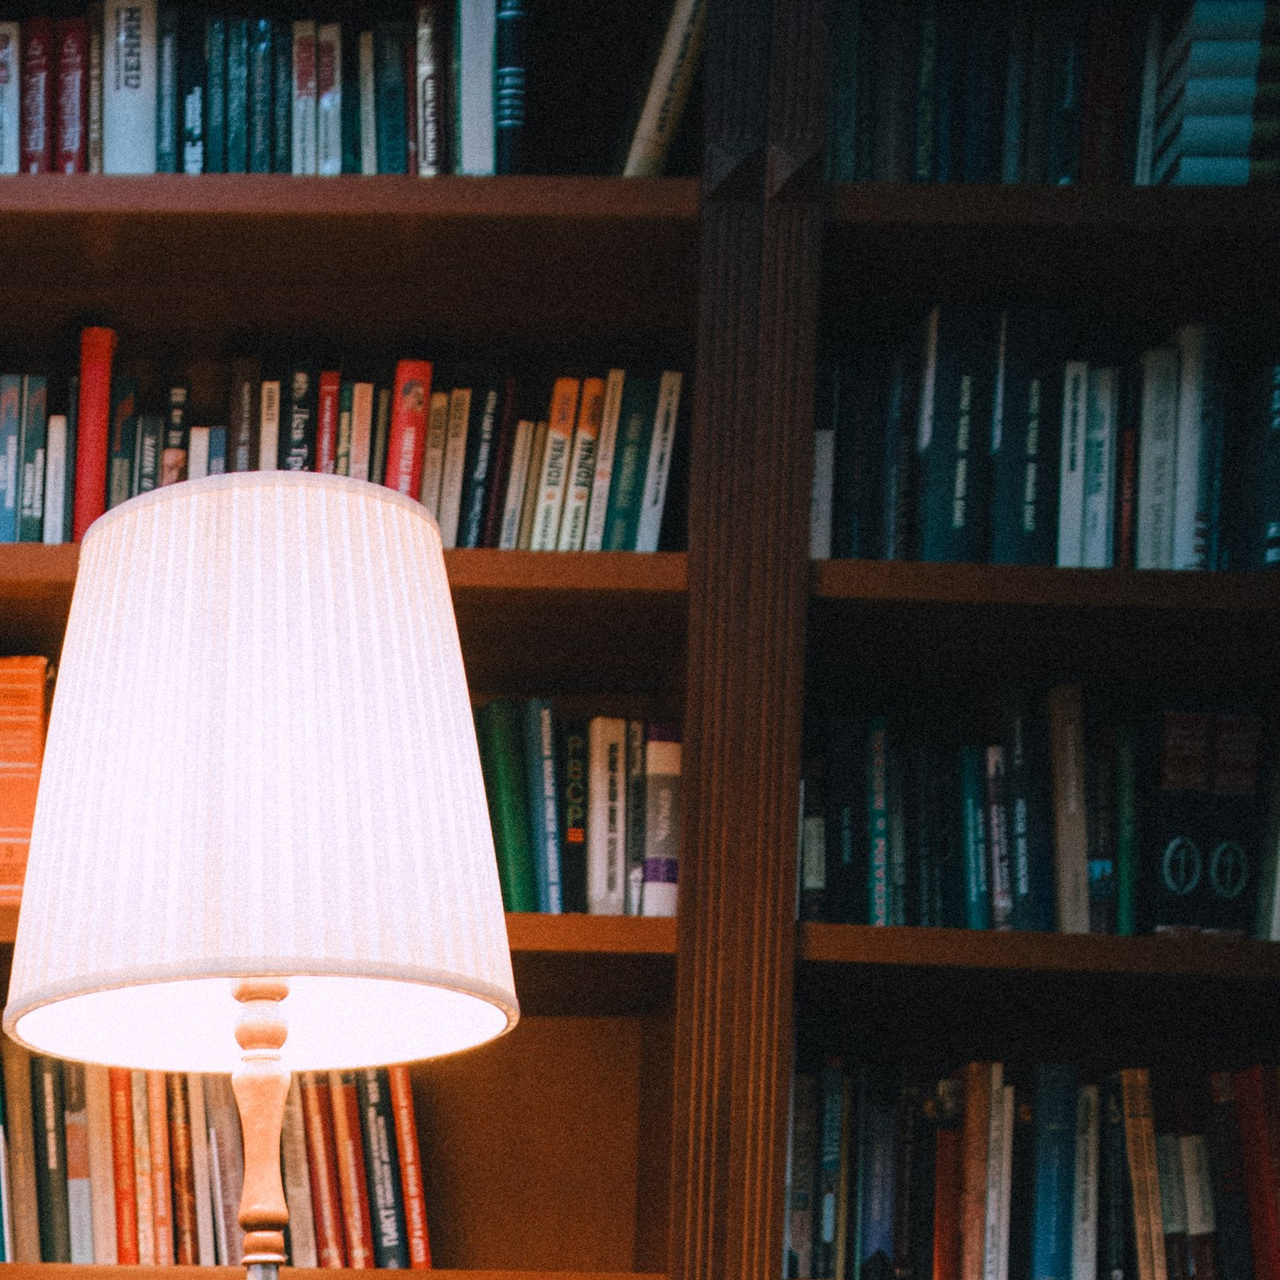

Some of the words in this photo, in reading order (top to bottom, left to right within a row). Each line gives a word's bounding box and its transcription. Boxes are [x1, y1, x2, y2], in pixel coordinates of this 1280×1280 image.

[123, 5, 141, 89] ЛЕНИН
[545, 437, 566, 488] КОЛЧАК
[574, 438, 595, 488] КОЛЧАК
[380, 1206, 400, 1247] ПАКТ
